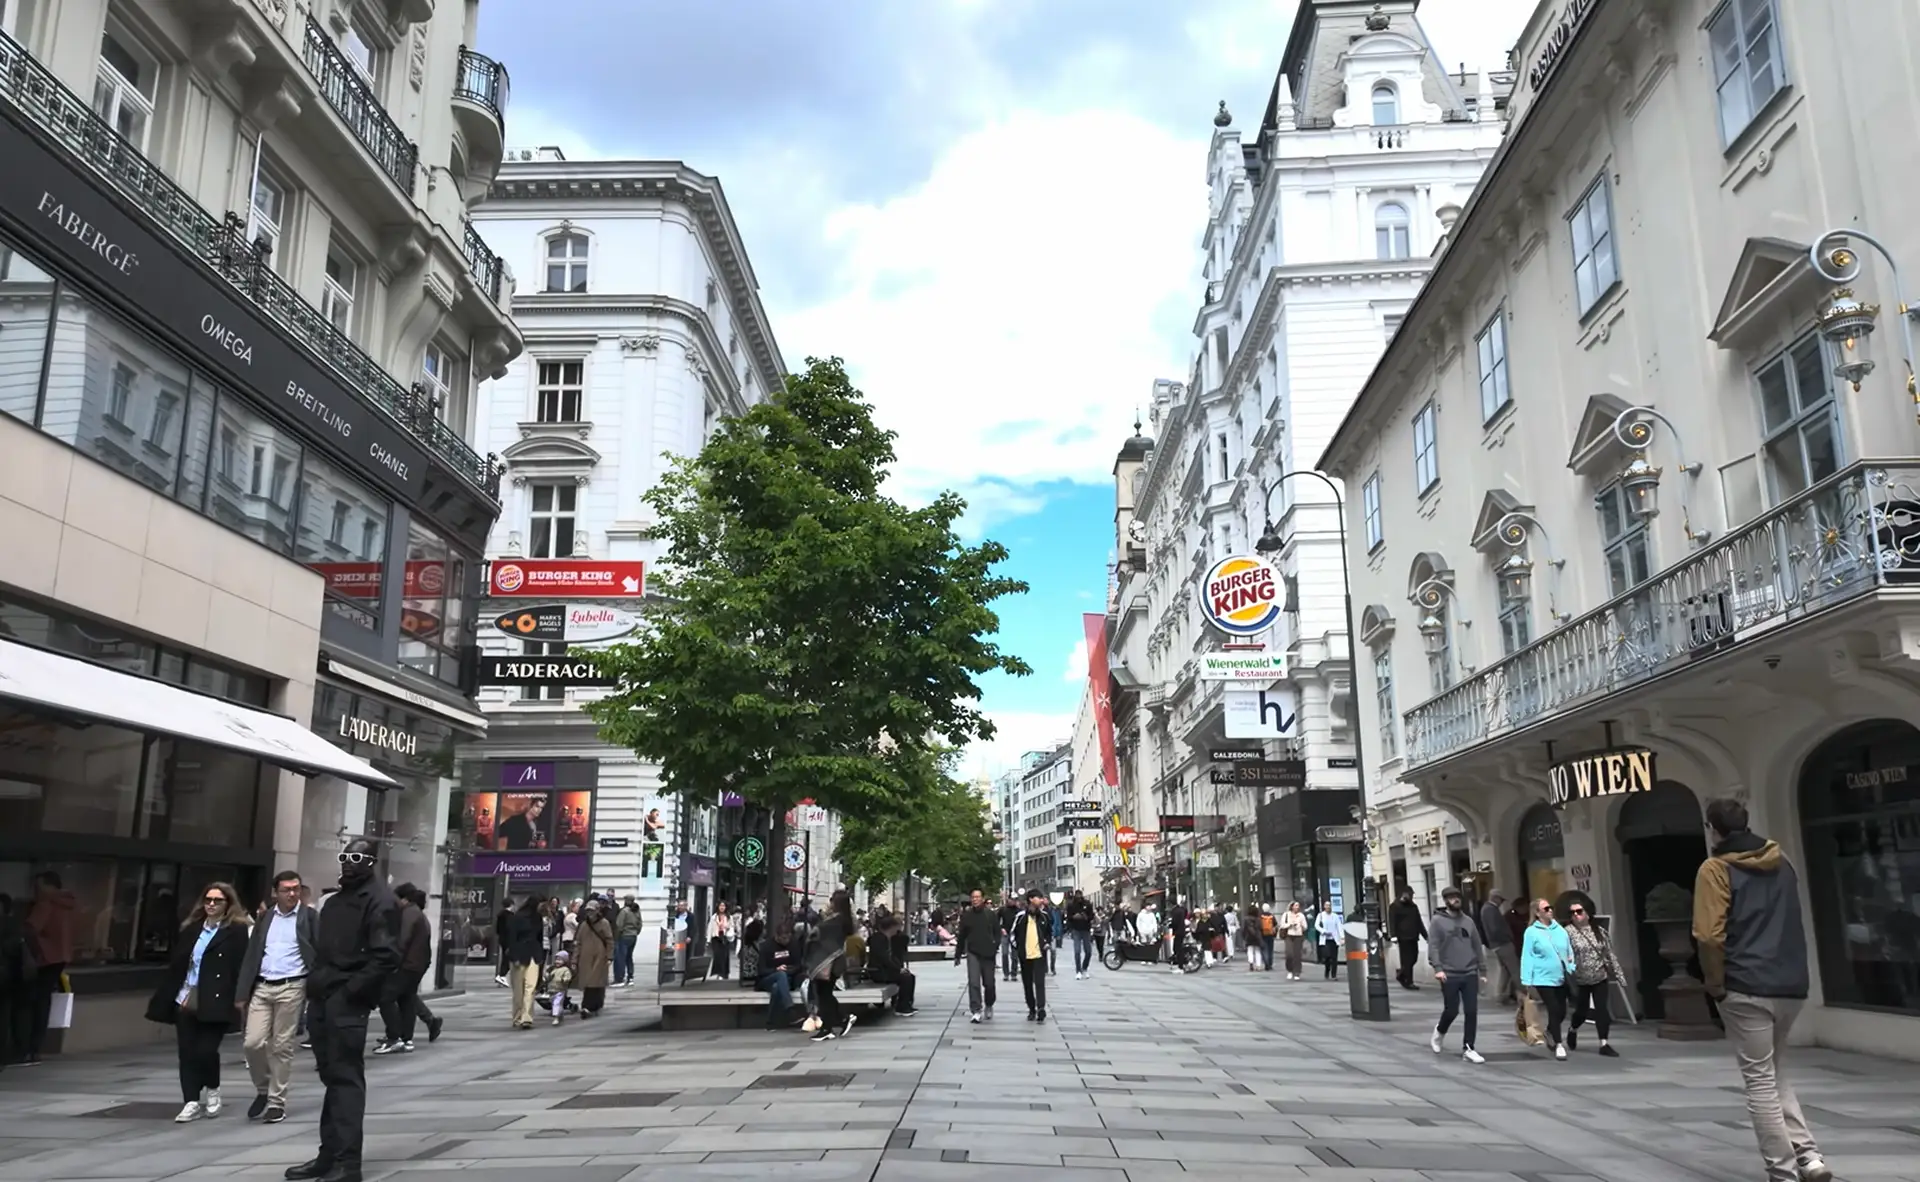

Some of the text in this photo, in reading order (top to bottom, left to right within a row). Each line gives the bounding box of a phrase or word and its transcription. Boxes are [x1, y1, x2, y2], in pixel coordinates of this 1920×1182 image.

[37, 190, 138, 275] FABERGÉ
[201, 314, 252, 365] OMEGA
[285, 380, 352, 437] BREITLING
[369, 442, 409, 481] CHANEL
[500, 575, 521, 585] KING
[528, 571, 612, 580] BURGER KING
[1210, 567, 1272, 597] BURGER
[1214, 581, 1275, 617] KING
[495, 662, 602, 679] LÄDERACH
[1206, 657, 1270, 669] Wienerwald
[1234, 669, 1283, 677] Restaurant
[339, 714, 417, 756] LÄDERACH
[1571, 751, 1651, 799] WIEN
[493, 860, 551, 875] Marionnaud
